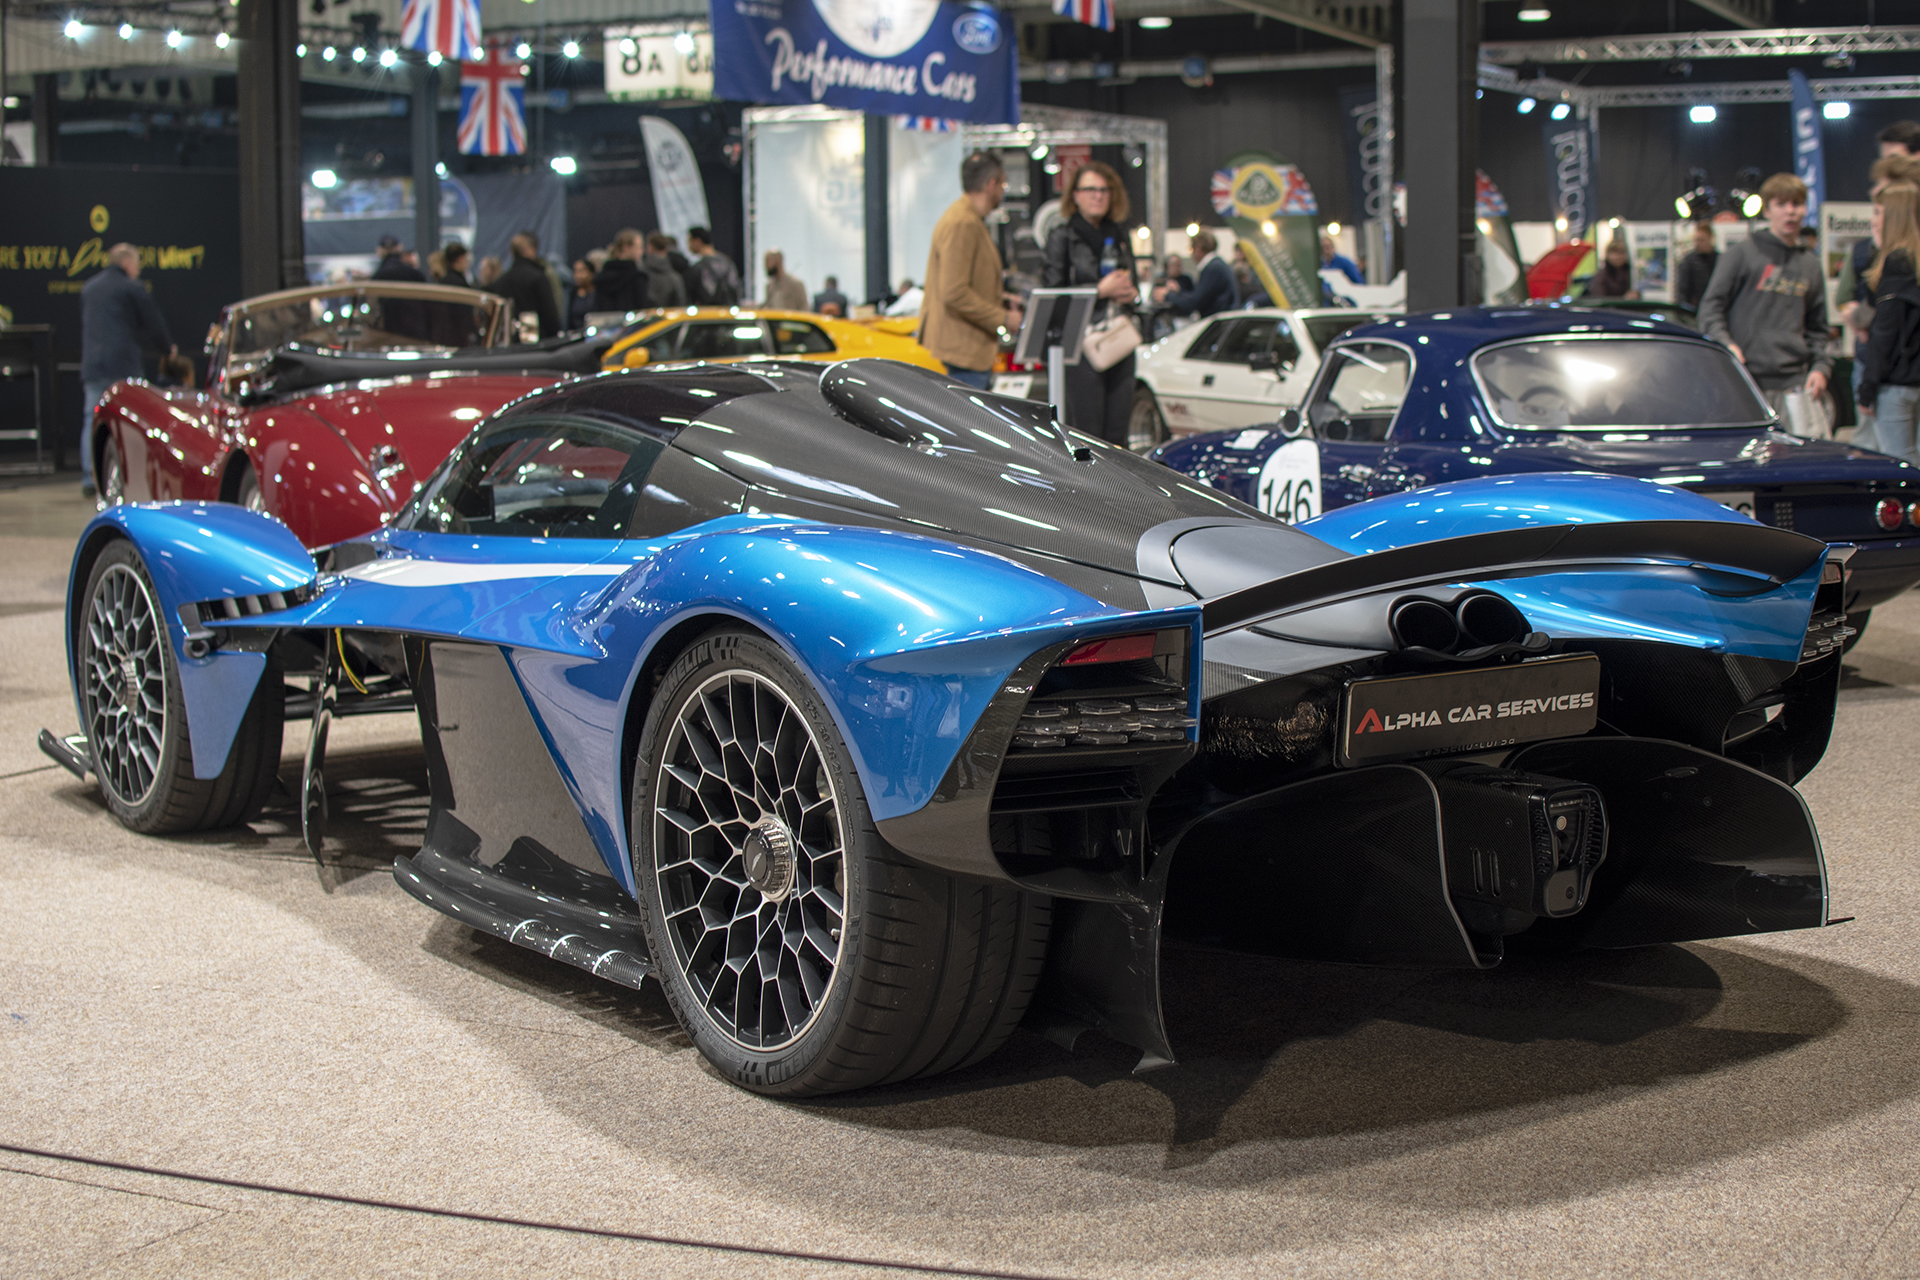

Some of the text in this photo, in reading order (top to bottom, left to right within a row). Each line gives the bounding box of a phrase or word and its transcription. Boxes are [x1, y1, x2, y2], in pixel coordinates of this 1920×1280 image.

[765, 26, 918, 101] Performance
[921, 51, 977, 103] Cars
[23, 246, 58, 269] YOU
[1263, 478, 1313, 524] 146
[649, 640, 710, 731] MICHELIN
[1354, 691, 1595, 735] ALPHA CAR SERVICES
